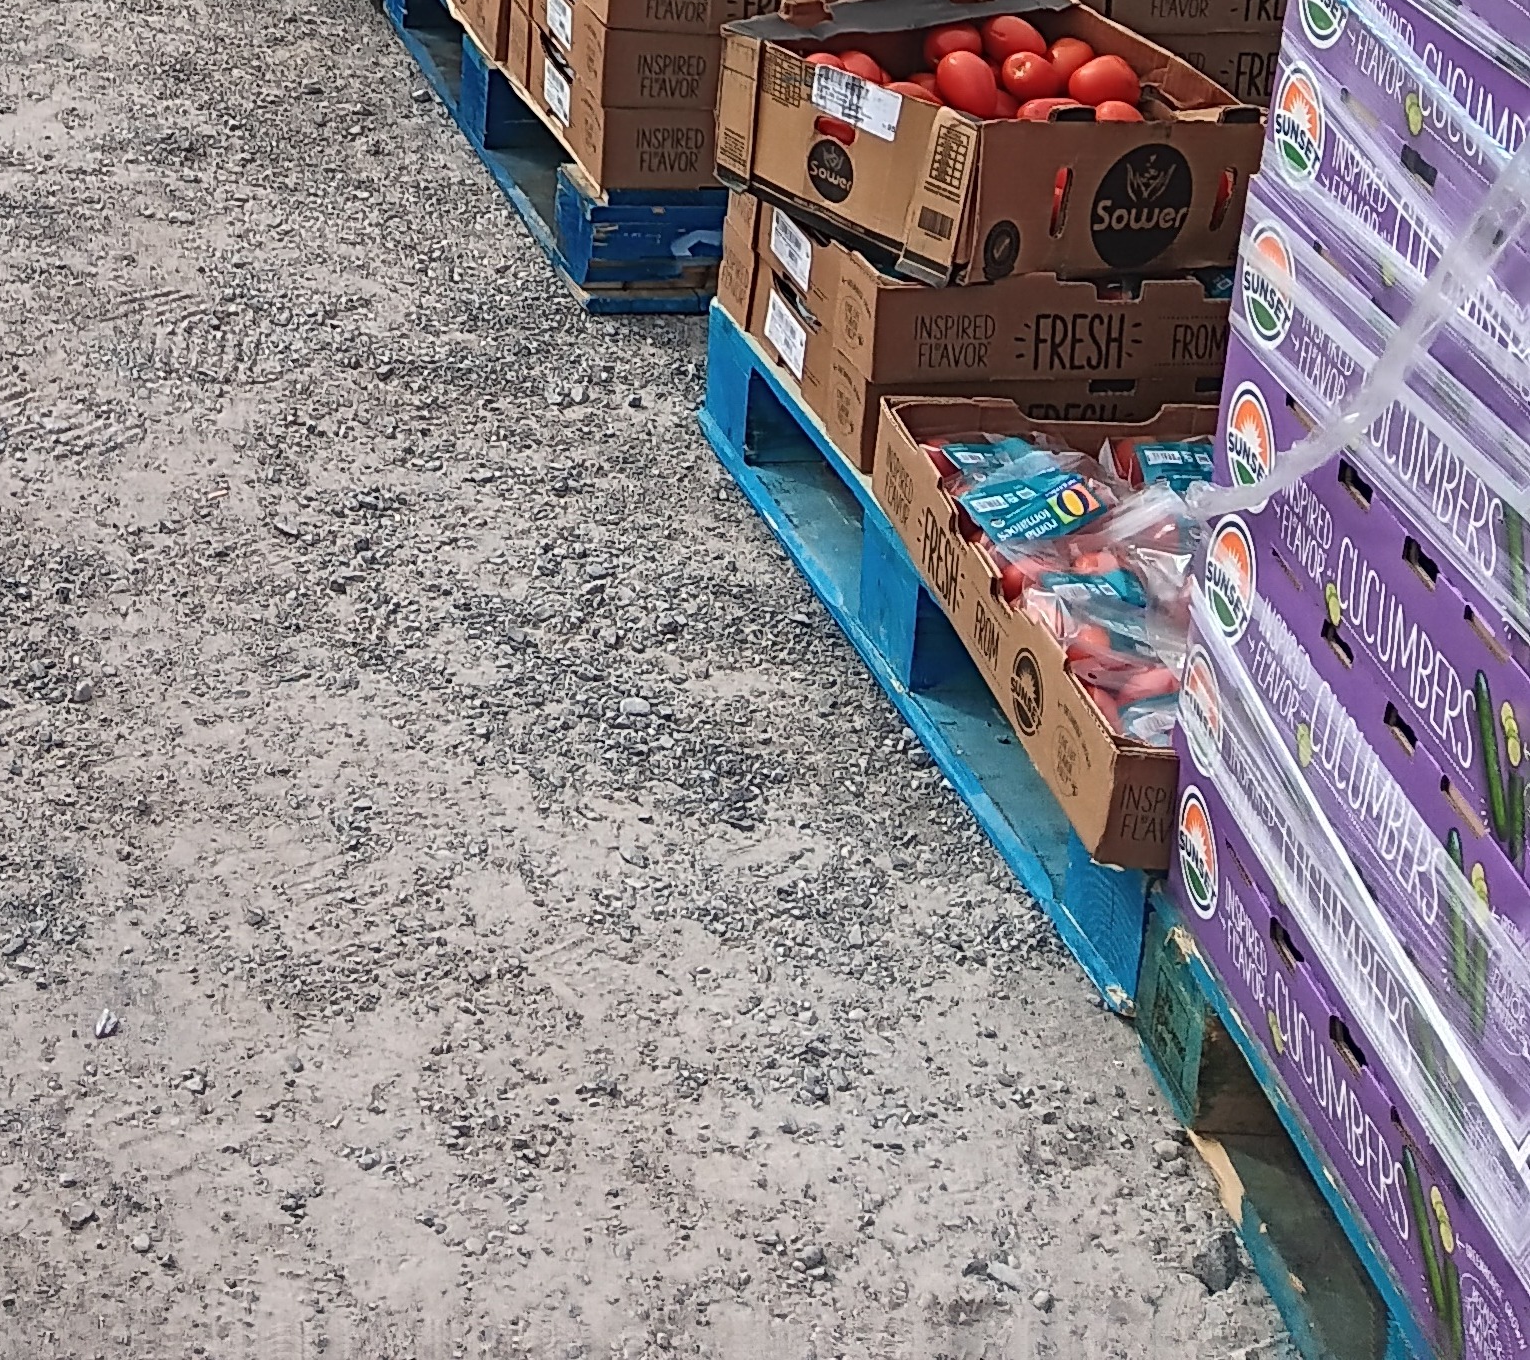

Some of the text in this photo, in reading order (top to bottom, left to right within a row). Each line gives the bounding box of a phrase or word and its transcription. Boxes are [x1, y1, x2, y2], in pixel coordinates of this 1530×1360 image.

[637, 54, 707, 76] INSPIRED
[639, 76, 700, 98] FLAVOR
[1234, 52, 1274, 98] FRE
[1353, 29, 1405, 104] FLAVOR
[635, 127, 705, 150] INSPIRED
[639, 150, 699, 173] FLAVOR
[1275, 113, 1321, 169] SUNSET
[809, 160, 853, 192] Sower
[1331, 132, 1389, 214] INSPIRED
[1092, 199, 1189, 231] Sower
[1243, 269, 1292, 330] SUNSET
[913, 313, 1226, 371] INSPIRED FRESH FROM
[917, 342, 990, 369] FLAVOR
[1227, 431, 1268, 483] SUNSE
[1367, 392, 1504, 578] UCUMBERS
[996, 508, 1053, 542] tomatoes
[1024, 520, 1059, 541] roma
[1282, 479, 1333, 550] INSPIRED
[921, 506, 960, 614] FRESH
[1206, 559, 1247, 632] SUNSET
[973, 600, 1000, 672] FROM
[1279, 508, 1477, 770] FLAVOR CUCUMBERS
[1011, 676, 1043, 732] SUNSET
[1251, 637, 1446, 926] FLAVOR CUCUMBERS
[1225, 875, 1268, 977] INSPIRED
[1227, 918, 1267, 1015] FLAVOR
[1274, 970, 1409, 1241] CUCUMBERS
